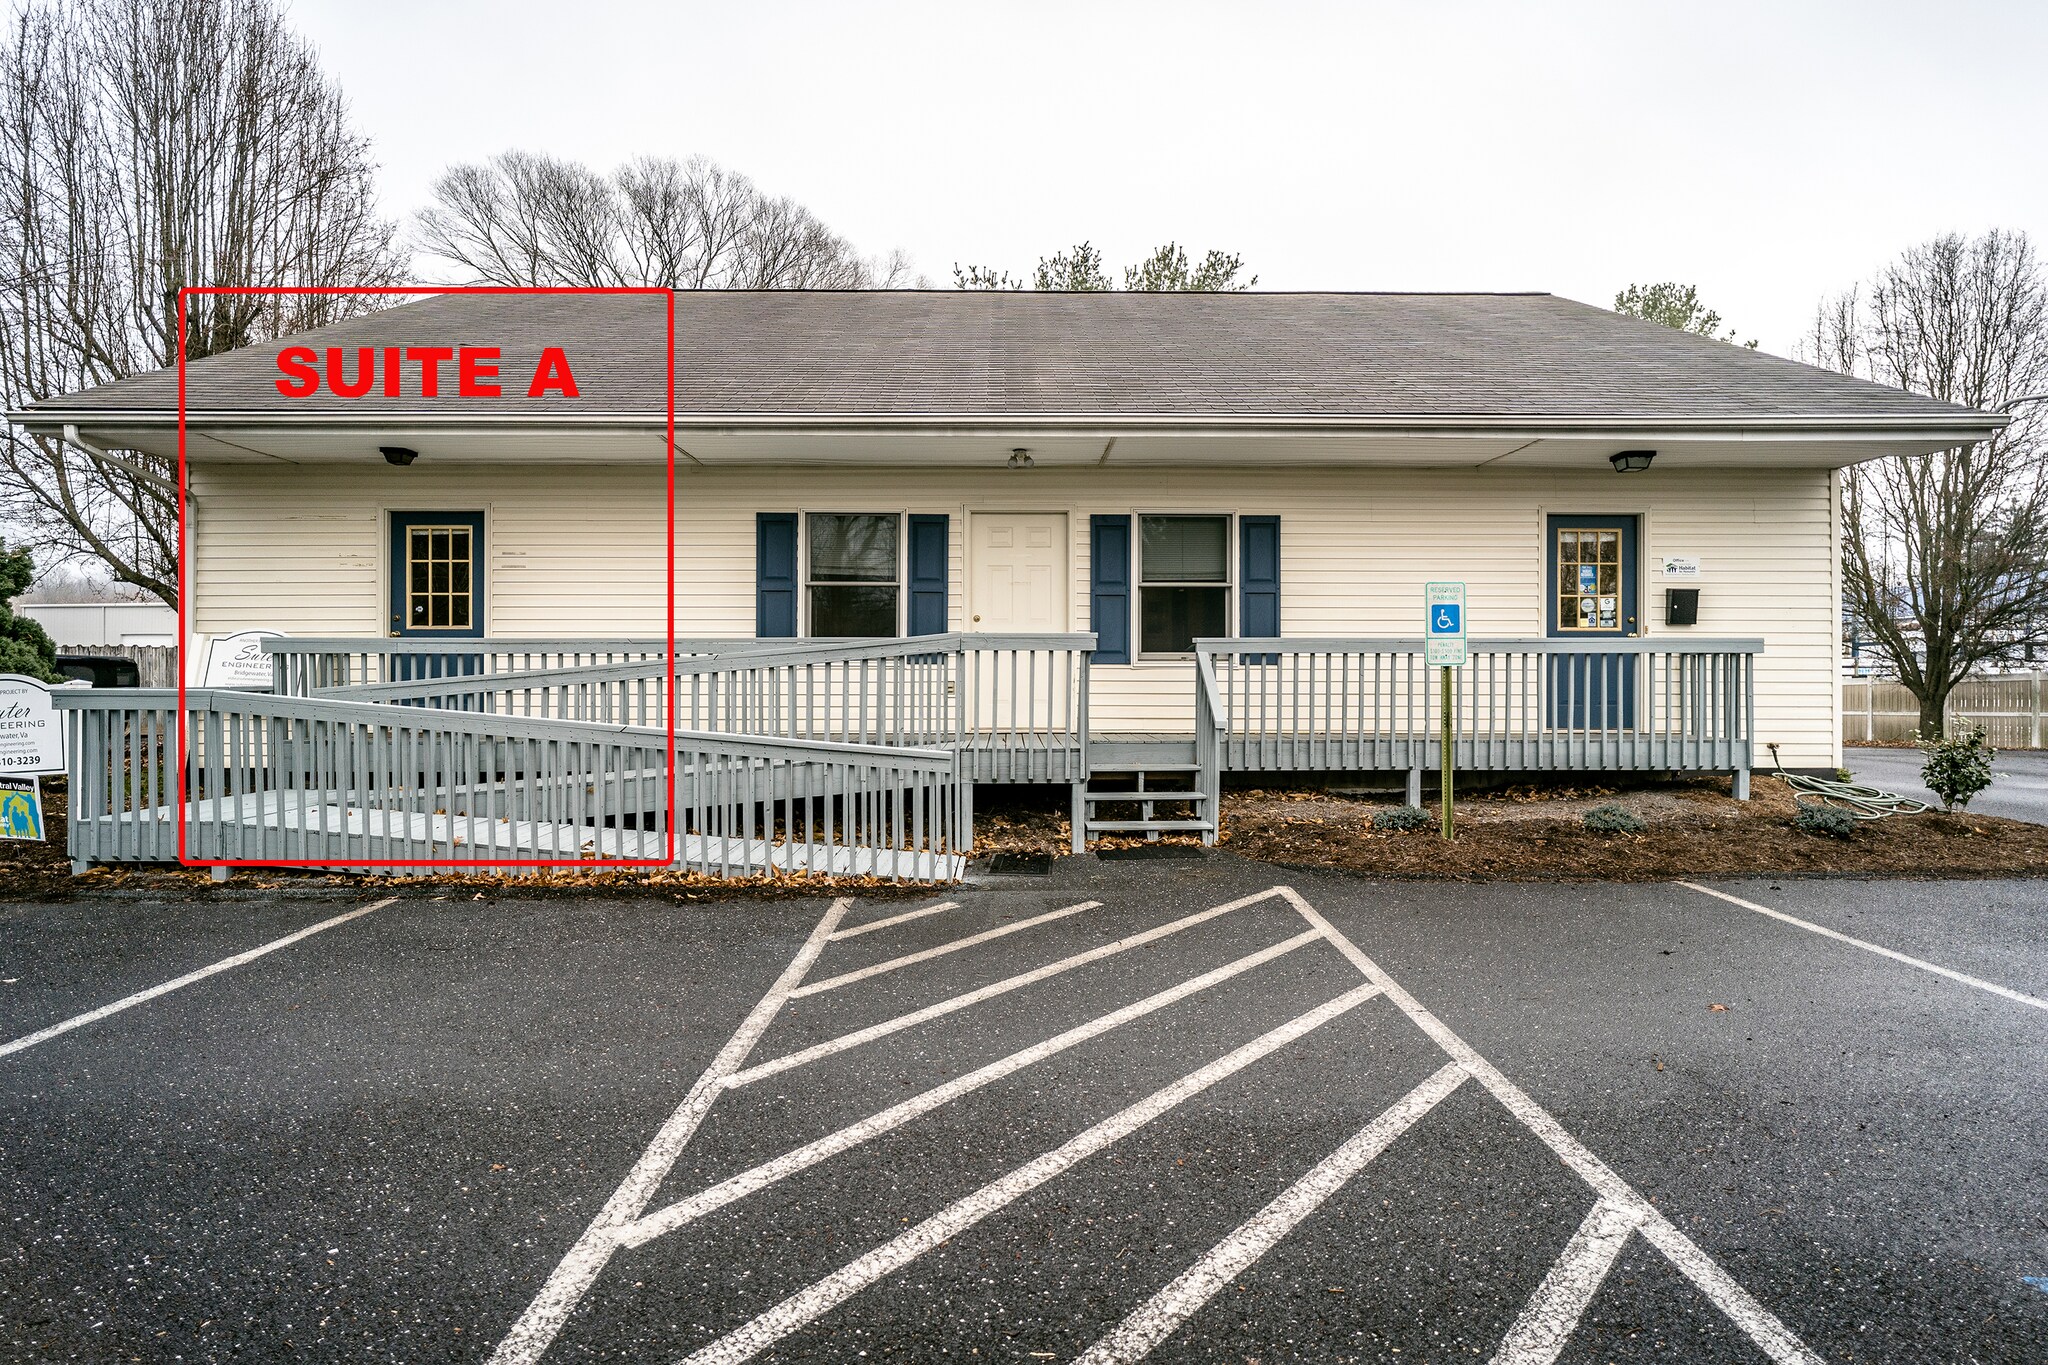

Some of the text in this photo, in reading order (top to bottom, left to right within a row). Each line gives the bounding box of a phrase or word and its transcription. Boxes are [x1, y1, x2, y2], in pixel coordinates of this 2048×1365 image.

[235, 644, 274, 661] Sute
[0, 755, 41, 766] 10-3239
[12, 782, 35, 792] Valley
